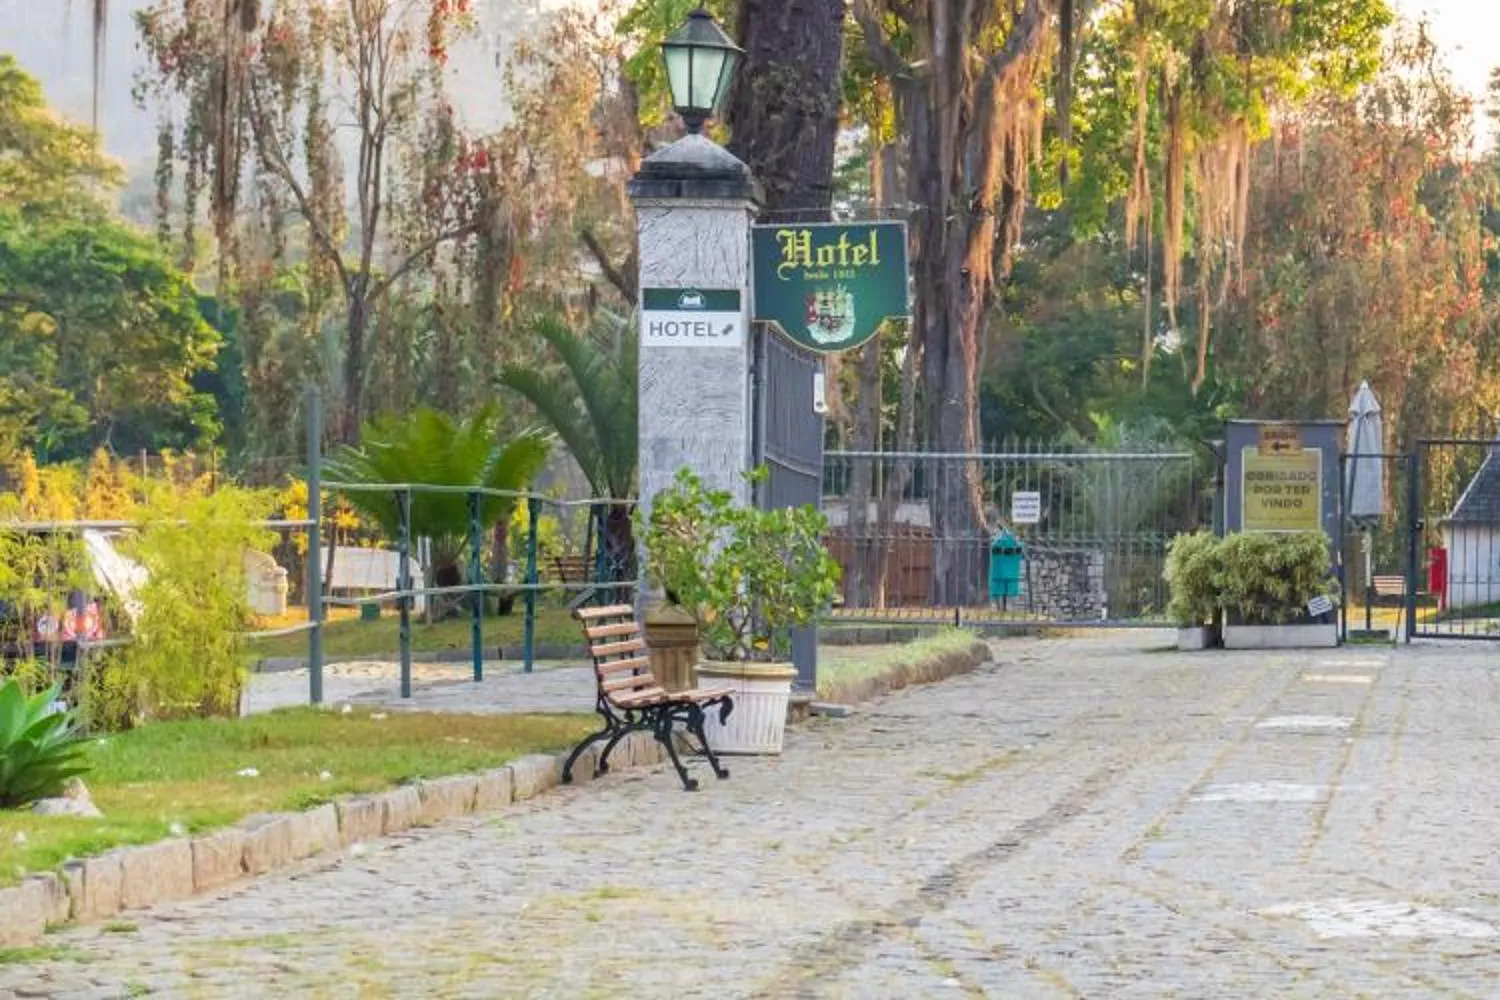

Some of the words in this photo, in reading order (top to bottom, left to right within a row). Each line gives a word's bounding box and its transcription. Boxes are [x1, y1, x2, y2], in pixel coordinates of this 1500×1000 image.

[776, 229, 881, 280] Hotel
[649, 321, 718, 338] HOTEL
[1262, 498, 1303, 508] VINDO
